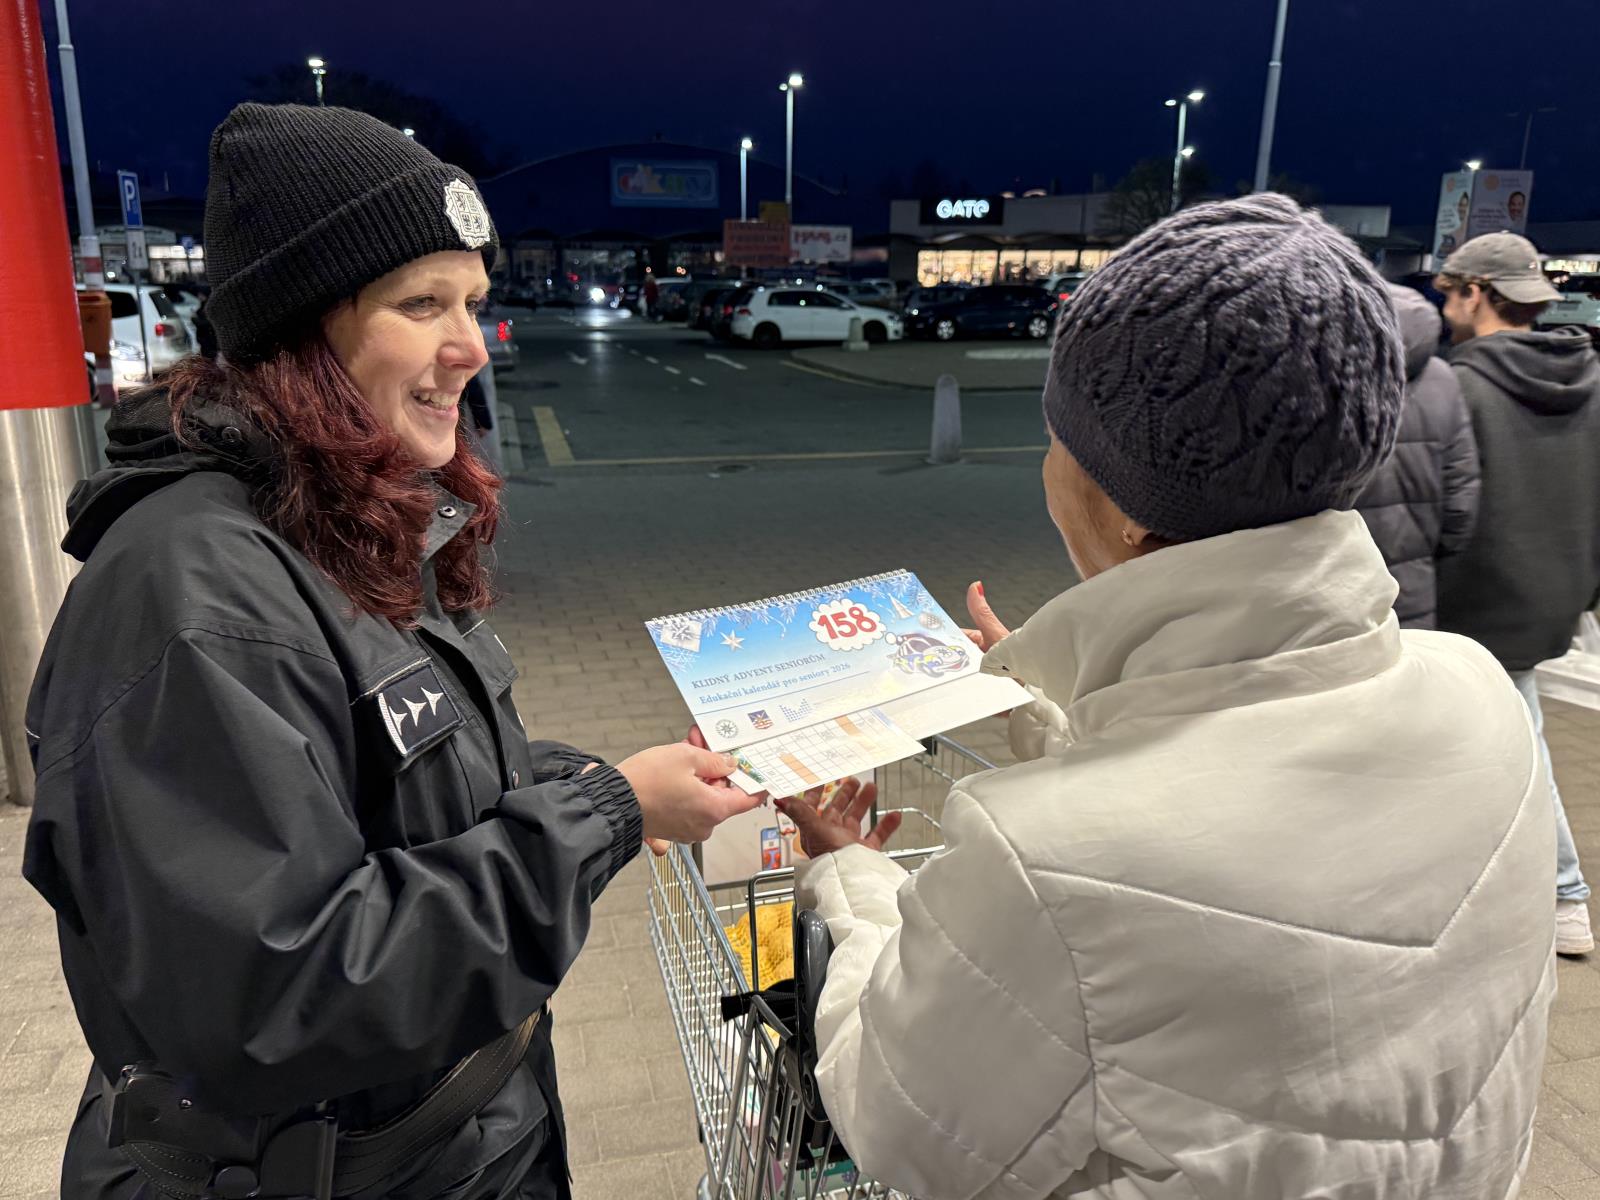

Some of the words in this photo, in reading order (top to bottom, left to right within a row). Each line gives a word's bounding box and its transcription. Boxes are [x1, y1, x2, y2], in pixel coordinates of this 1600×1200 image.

[124, 179, 135, 211] P
[817, 606, 877, 640] 158
[691, 673, 730, 689] KLIDNÝ
[733, 664, 774, 682] ADVENT
[774, 653, 826, 672] SENIORŮM
[699, 687, 743, 704] Edukační
[743, 679, 781, 695] kalendář
[782, 677, 798, 688] pro
[799, 667, 830, 682] seniory
